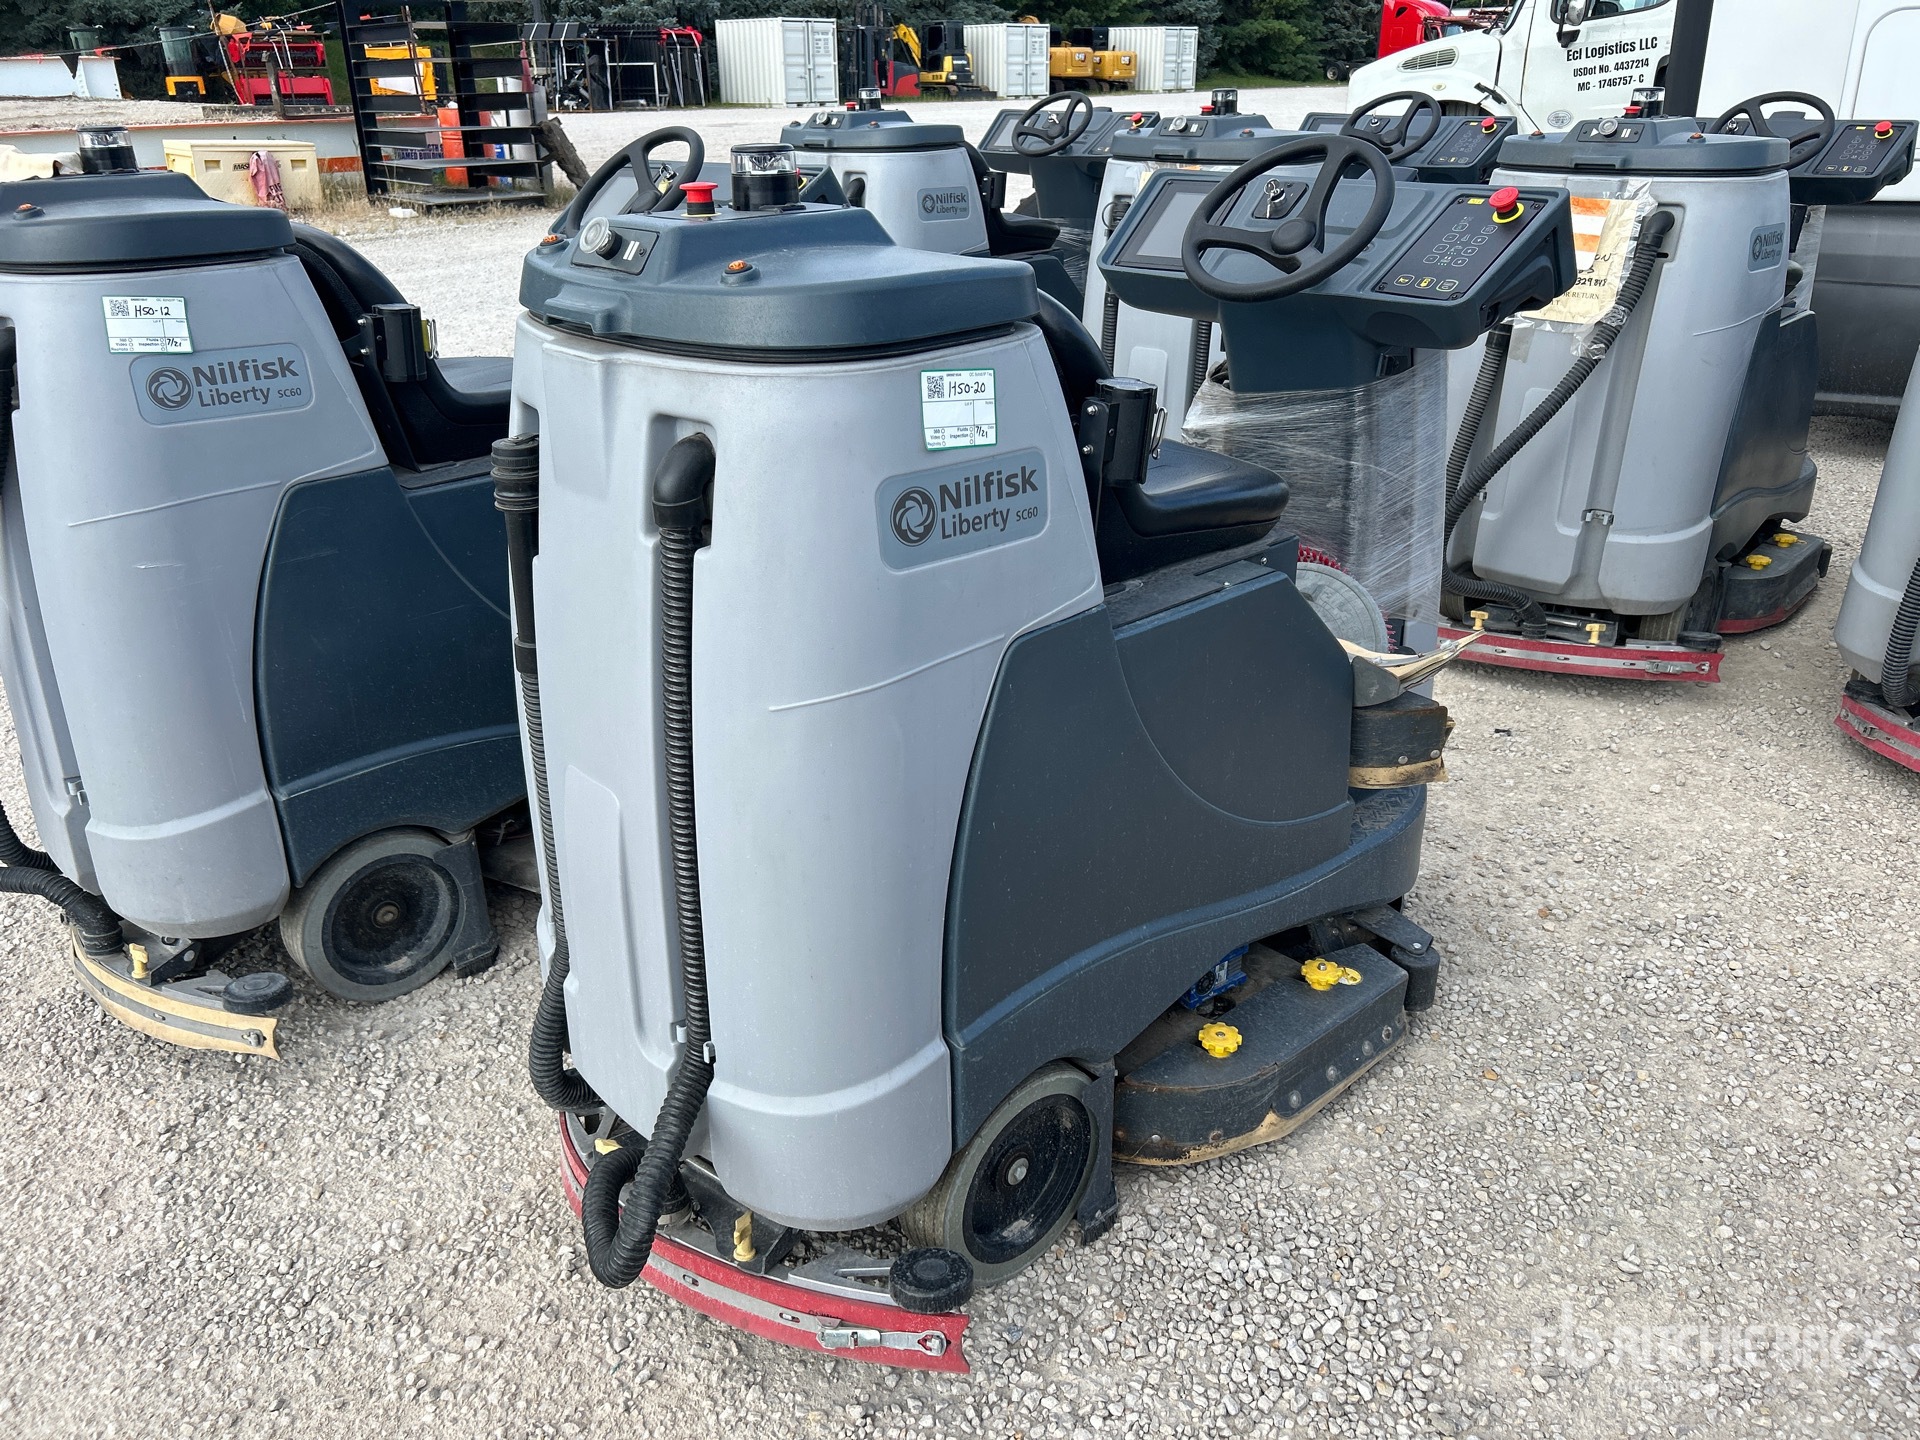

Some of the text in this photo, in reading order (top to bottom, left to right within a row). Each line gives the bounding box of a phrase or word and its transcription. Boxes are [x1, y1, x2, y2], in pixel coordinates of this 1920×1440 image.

[1585, 40, 1636, 58] Logistics
[1639, 37, 1658, 51] LLC
[1573, 58, 1649, 77] USDot No. 4437214
[1577, 81, 1591, 92] MC
[1639, 74, 1644, 83] C
[936, 193, 967, 204] Nilfisk
[192, 357, 299, 388] Nilfisk
[197, 387, 302, 408] Liberty SC60
[939, 466, 1039, 512] Nilfisk
[941, 506, 1038, 540] Liberty SC60
